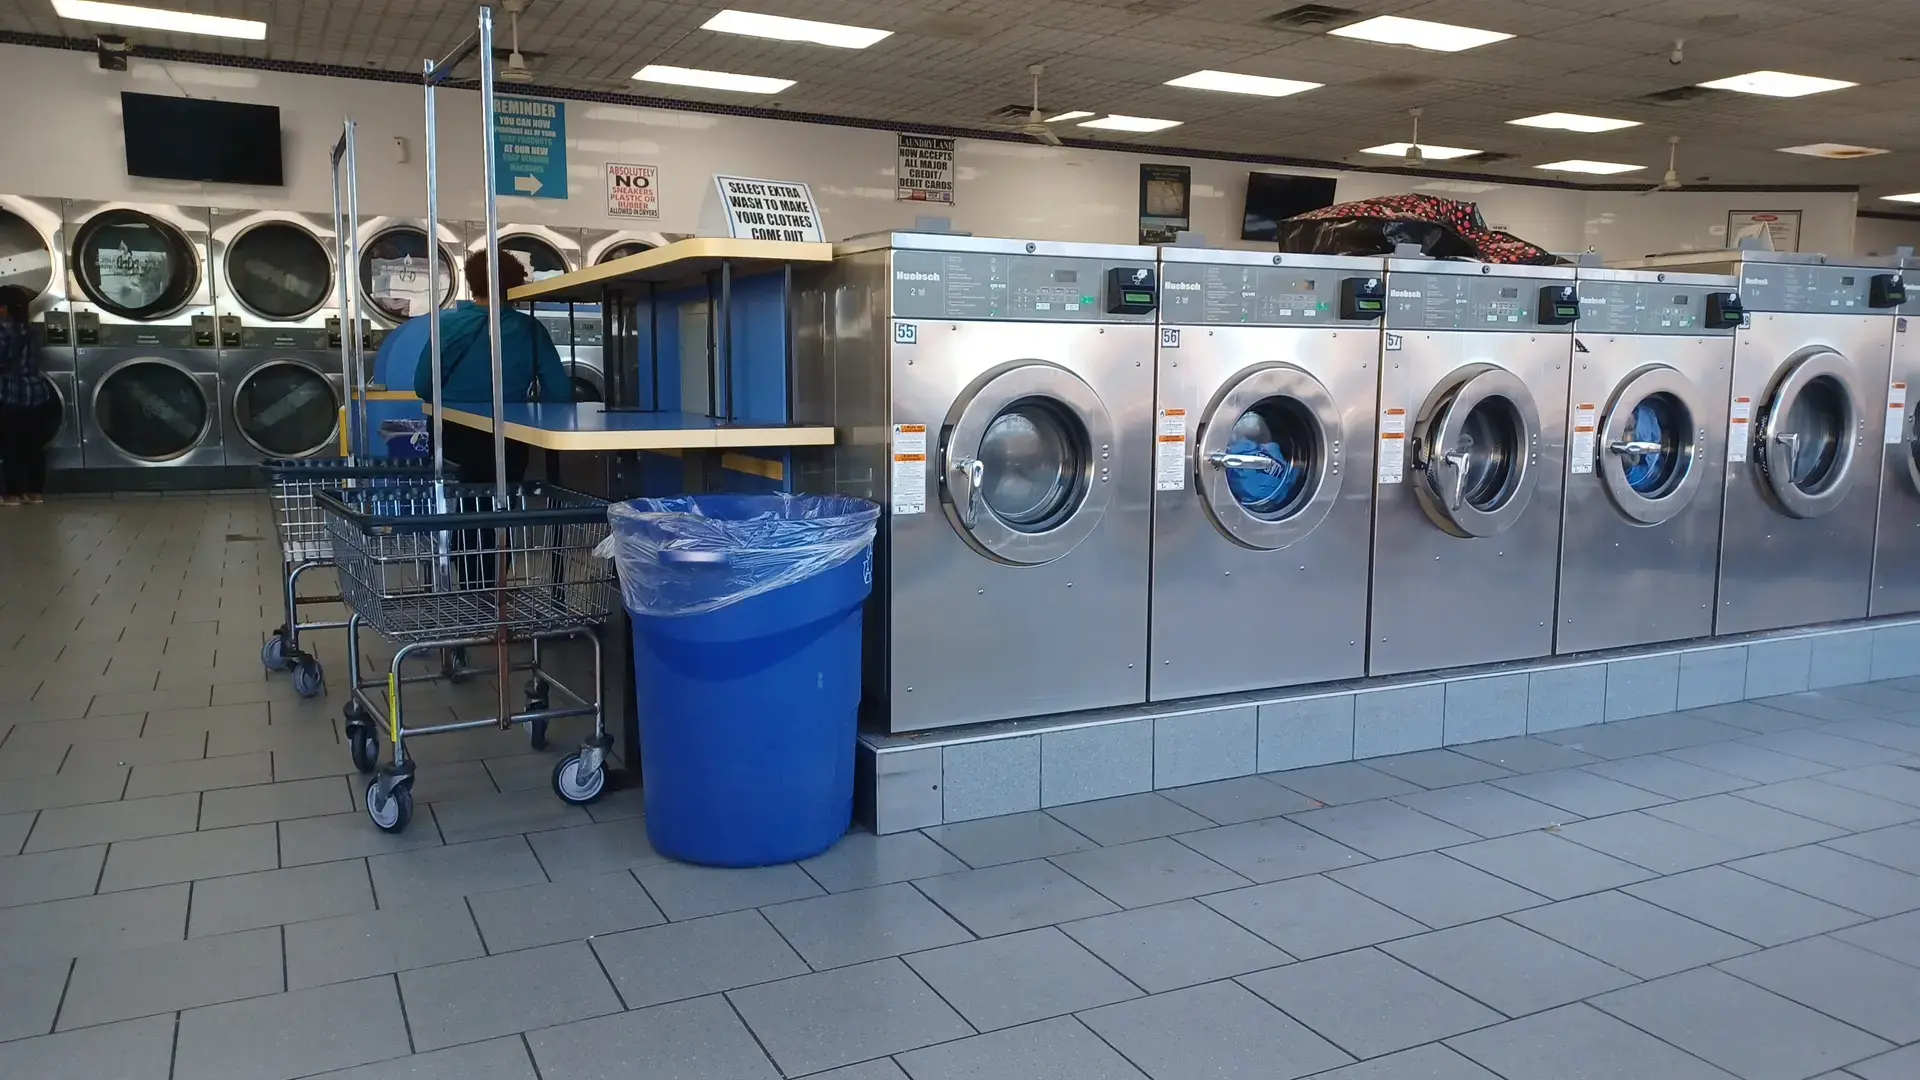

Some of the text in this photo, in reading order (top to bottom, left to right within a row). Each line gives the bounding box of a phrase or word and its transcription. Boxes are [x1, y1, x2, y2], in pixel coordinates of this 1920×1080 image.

[493, 98, 556, 118] REMINDER
[499, 116, 551, 129] YOU CAN NOW
[504, 144, 549, 156] AT OUR NEW
[899, 148, 952, 162] NOW ACCEPTS
[904, 159, 948, 171] ALL MAJOR
[609, 166, 655, 177] ABSOLUTELY
[909, 169, 942, 180] CREDIT/
[616, 175, 649, 188] NO
[900, 178, 952, 191] DEBIT CARDS
[612, 187, 653, 196] SNEAKERS
[728, 182, 801, 199] SELECT EXTRA
[610, 194, 643, 202] PLASTIC
[729, 195, 810, 213] WASH TO MAKE
[618, 201, 649, 210] RUBBER
[610, 207, 632, 215] ALLOWED
[639, 209, 657, 217] DRYERS
[735, 210, 812, 228] YOUR CLOTHES
[751, 228, 804, 242] COME OUT
[896, 270, 940, 282] Huebsch
[910, 287, 916, 296] 2
[1164, 281, 1201, 291] Huebsch
[1175, 296, 1181, 304] 2
[898, 324, 914, 338] 55
[1163, 330, 1177, 343] 56
[1388, 335, 1399, 346] 57
